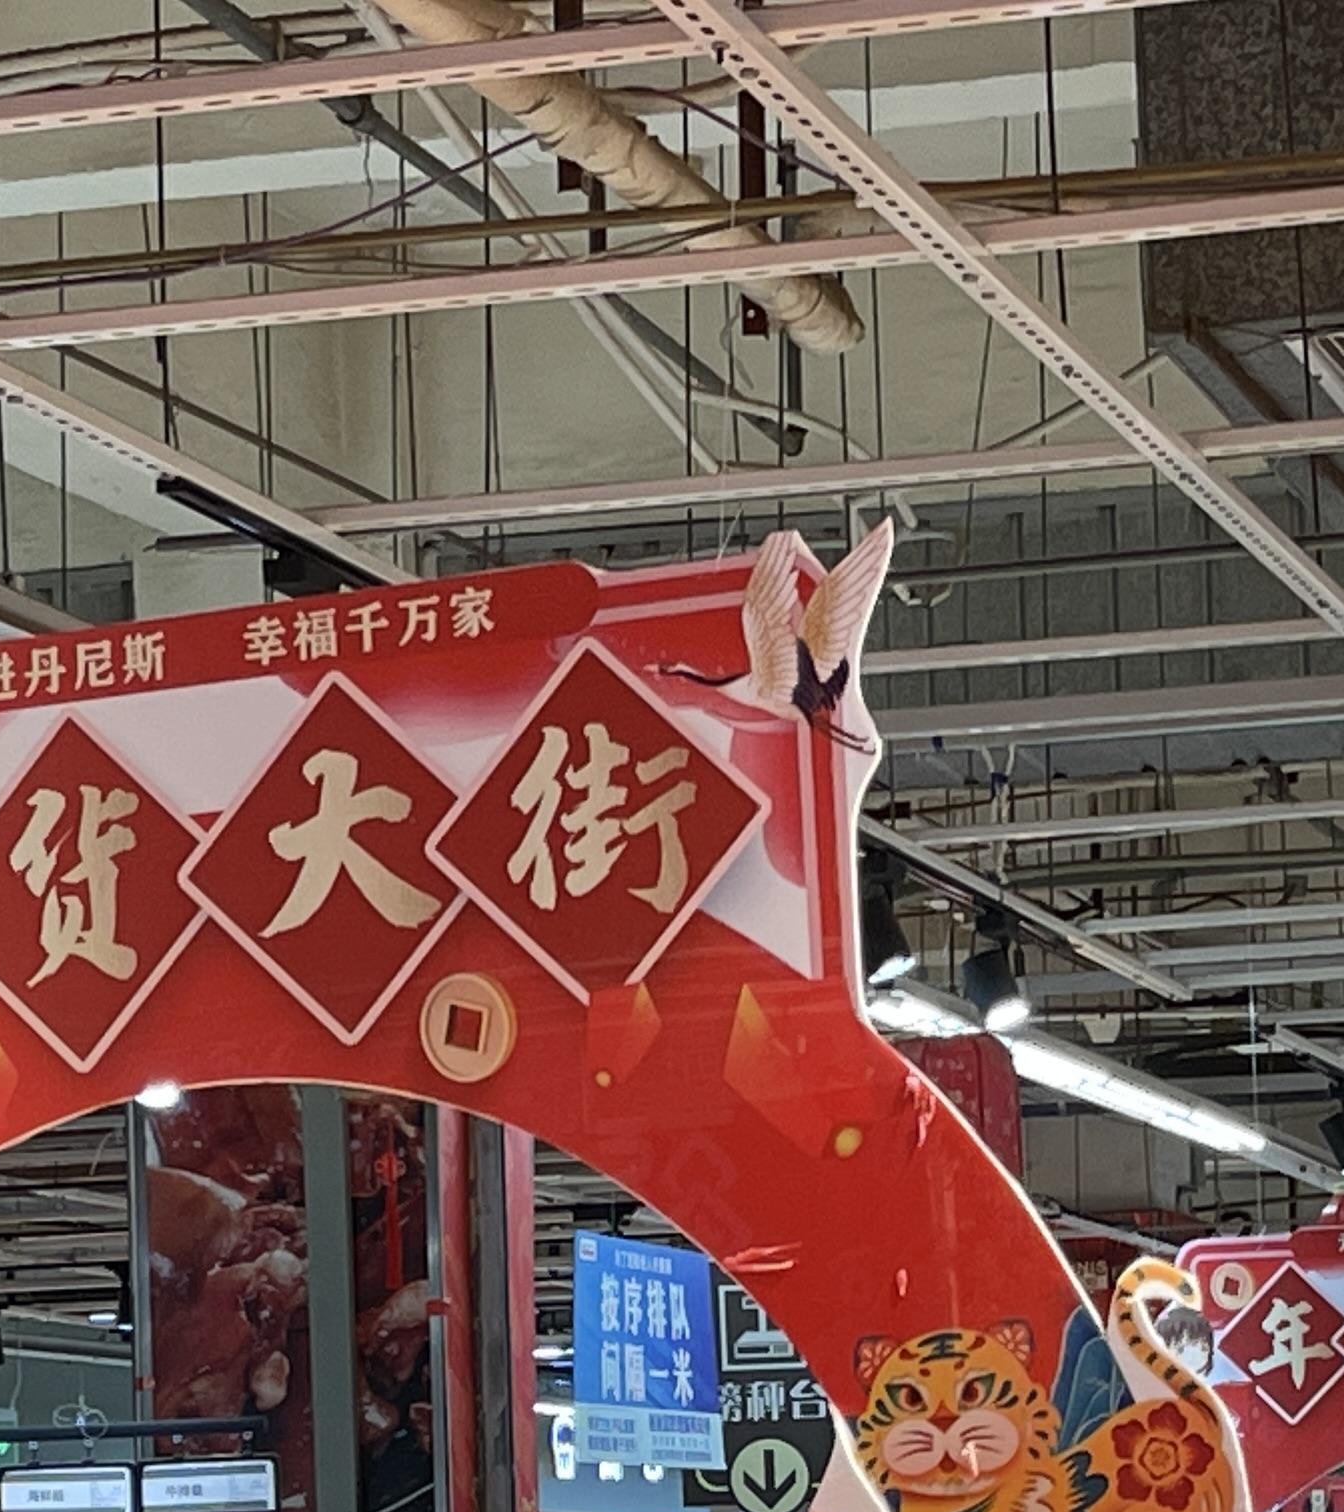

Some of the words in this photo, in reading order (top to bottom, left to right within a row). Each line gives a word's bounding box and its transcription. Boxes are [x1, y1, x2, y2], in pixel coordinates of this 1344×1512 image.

[243, 587, 497, 668] 幸福千万家
